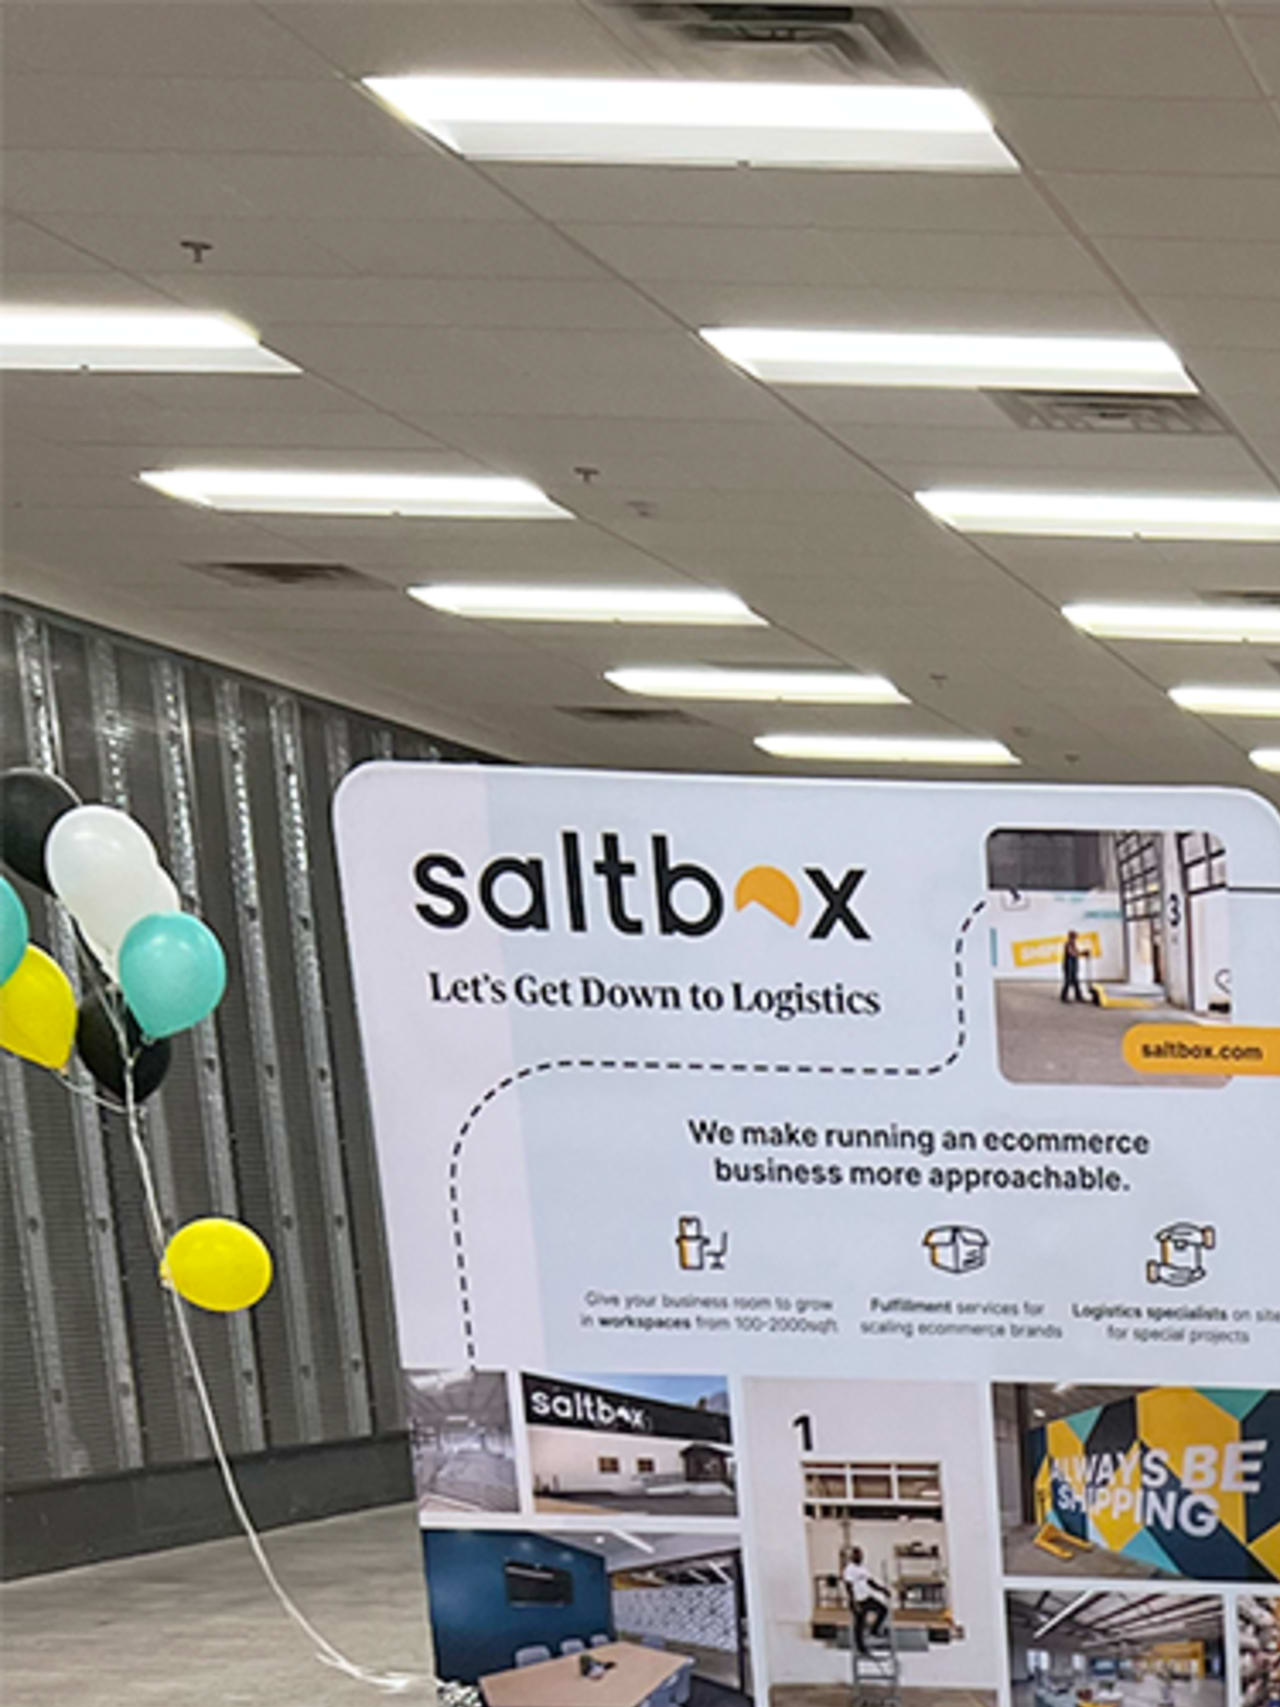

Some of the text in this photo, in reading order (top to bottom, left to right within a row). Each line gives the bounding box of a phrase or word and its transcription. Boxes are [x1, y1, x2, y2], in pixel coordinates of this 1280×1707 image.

[413, 831, 871, 940] saltbox
[428, 972, 880, 1019] Let's Get Down to Logistics
[1141, 1040, 1264, 1061] saltbox.com
[688, 1119, 1150, 1156] We make running an ecommerce
[714, 1157, 1130, 1192] business more approachable.
[585, 1290, 833, 1314] Give your business room to grow
[870, 1297, 1044, 1316] Fulfillment services for
[1071, 1303, 1143, 1321] Logistics
[1146, 1304, 1228, 1321] specialists
[1232, 1309, 1252, 1322] on
[580, 1313, 593, 1327] in
[599, 1315, 691, 1331] workspaces
[695, 1315, 731, 1330] from
[918, 1322, 1006, 1337] ecommerce
[1010, 1323, 1063, 1338] brands
[1107, 1324, 1250, 1344] for special projects
[531, 1389, 647, 1430] saltbox
[792, 1414, 813, 1452] 1
[1181, 1440, 1268, 1493] BE
[1057, 1484, 1219, 1538] SHIPPING
